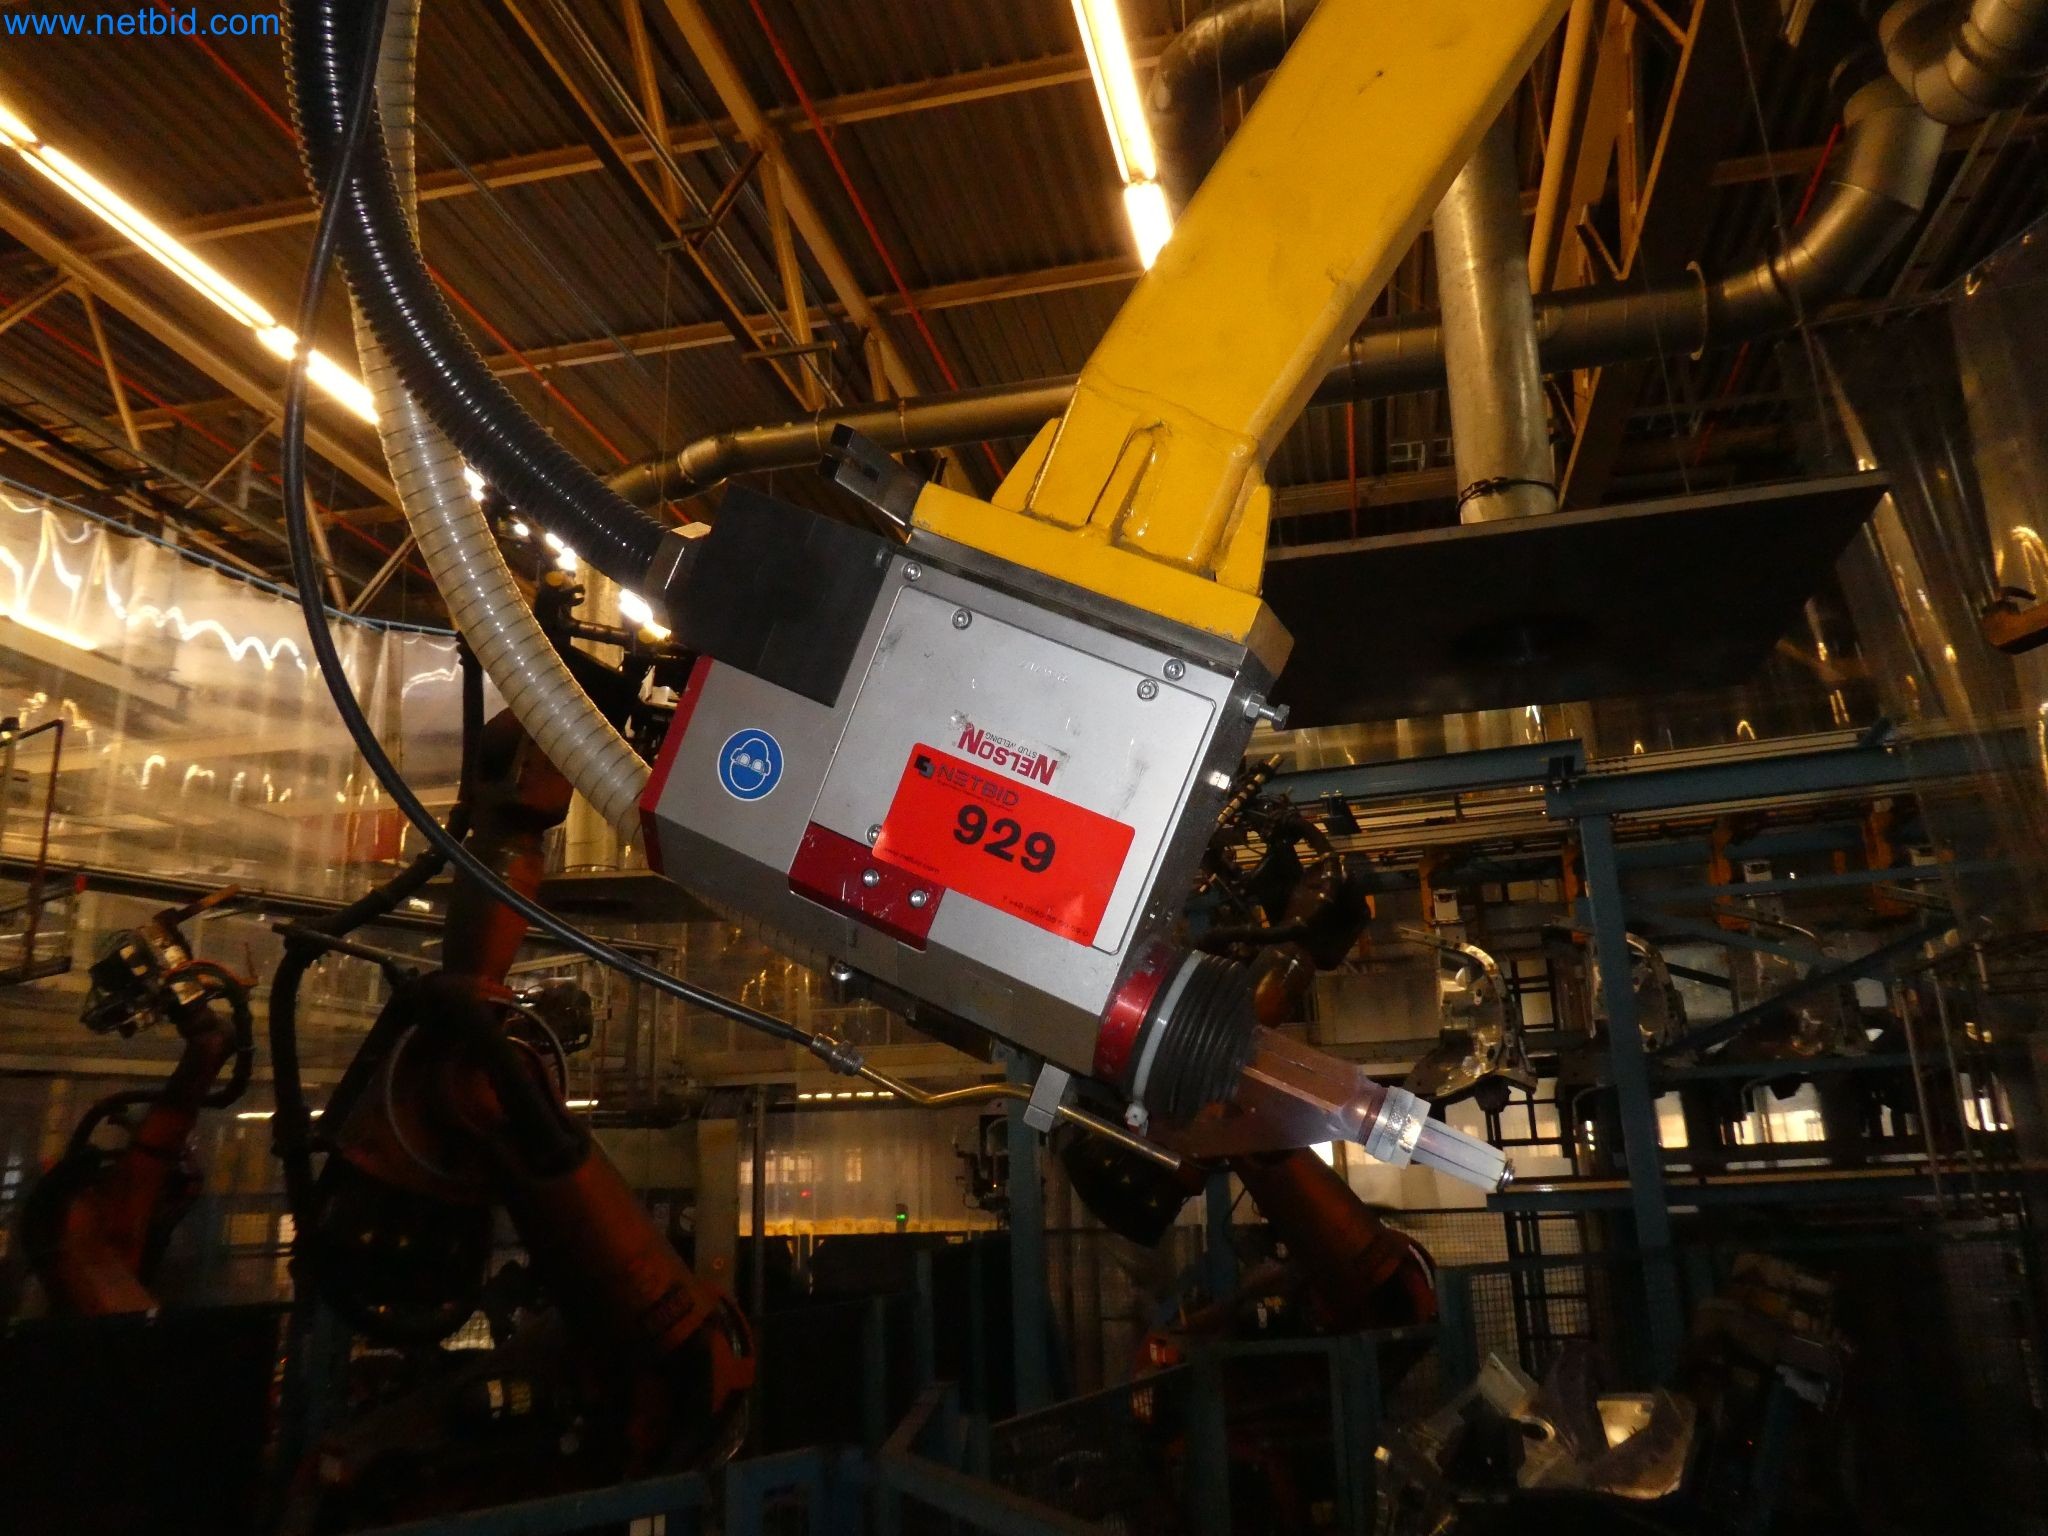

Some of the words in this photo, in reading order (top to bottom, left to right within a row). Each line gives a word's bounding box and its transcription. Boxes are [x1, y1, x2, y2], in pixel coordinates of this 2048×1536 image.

[958, 722, 1058, 786] NELSON
[1018, 745, 1038, 759] STUD
[938, 764, 1019, 806] NETBID
[953, 804, 1056, 873] 929
